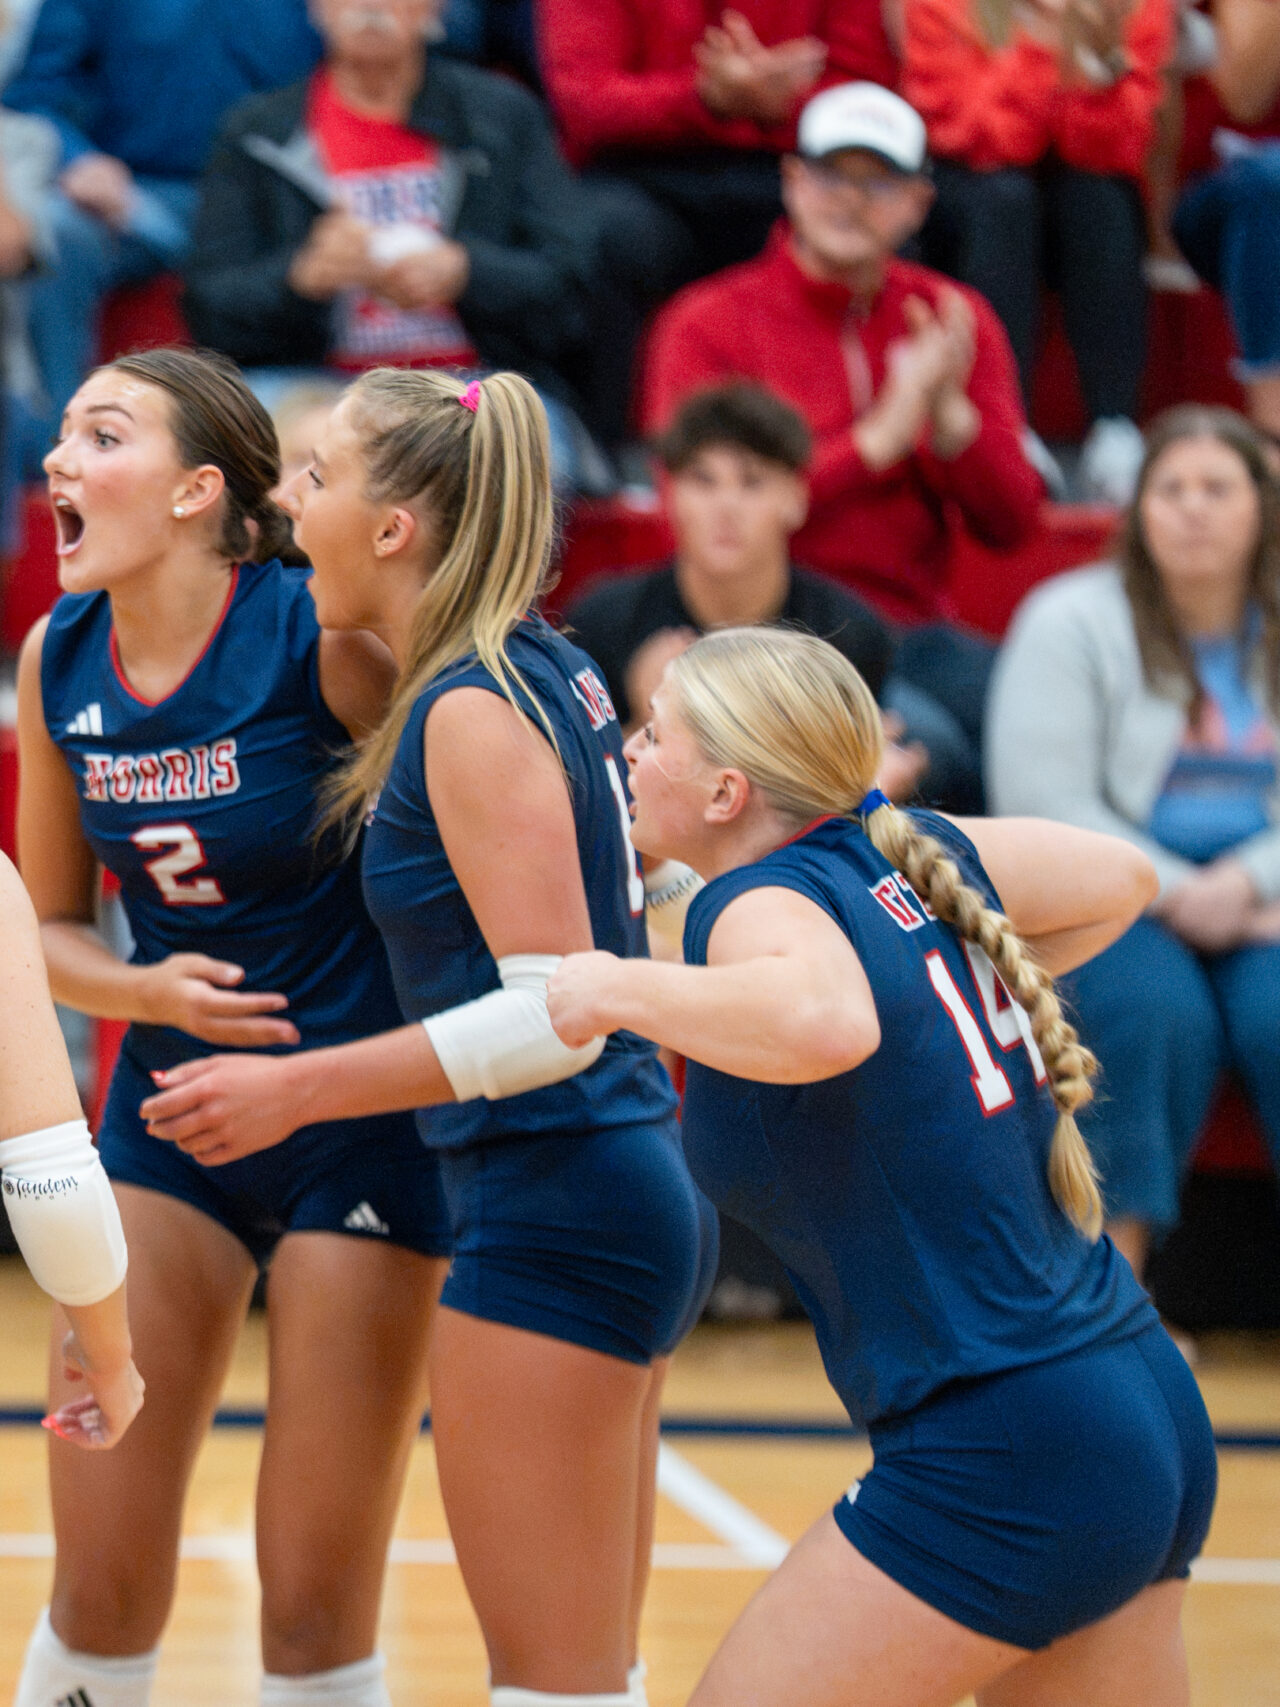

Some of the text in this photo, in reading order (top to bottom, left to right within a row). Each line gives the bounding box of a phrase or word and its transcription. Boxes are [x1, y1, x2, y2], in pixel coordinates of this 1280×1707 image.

[83, 737, 241, 804] NORRIS
[128, 821, 231, 907] 2
[924, 947, 1050, 1118] 14
[6, 1174, 79, 1200] Tandem
